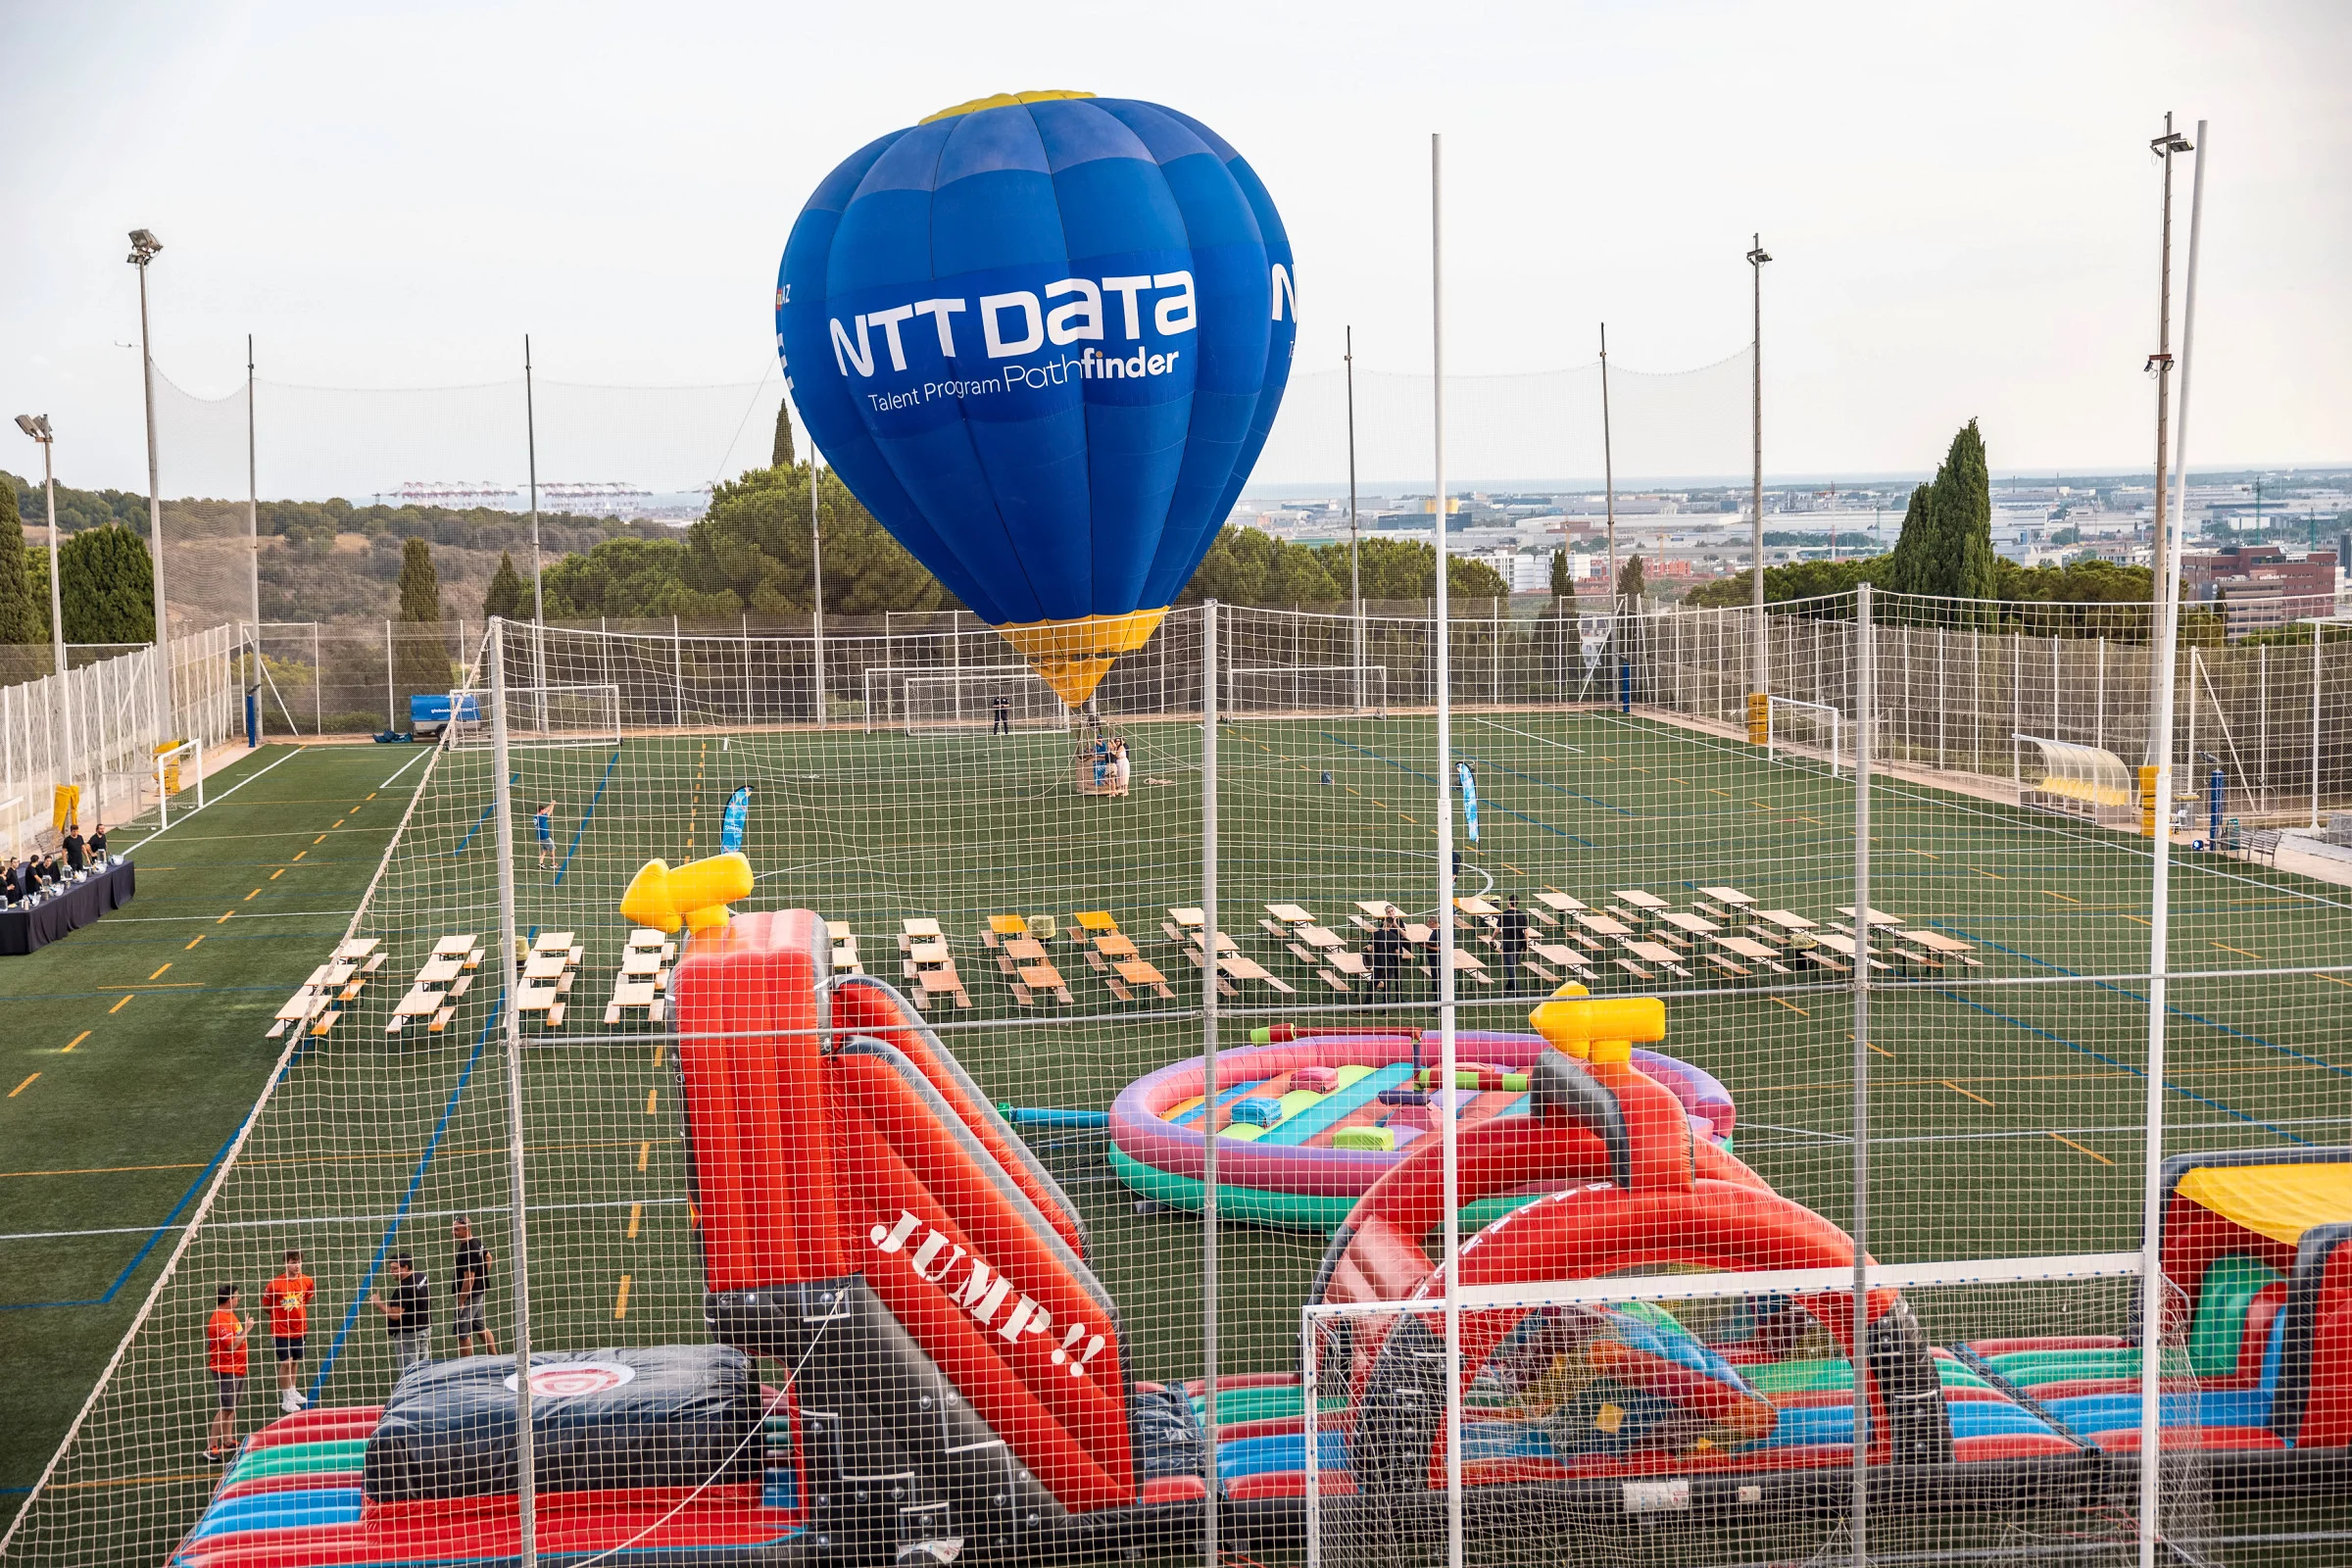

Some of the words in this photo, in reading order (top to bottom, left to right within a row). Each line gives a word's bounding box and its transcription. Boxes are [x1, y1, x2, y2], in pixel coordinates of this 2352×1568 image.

[829, 298, 966, 377] NTT
[867, 388, 920, 413] Talent
[924, 377, 1001, 402] Program
[1003, 345, 1180, 393] Pathfinder
